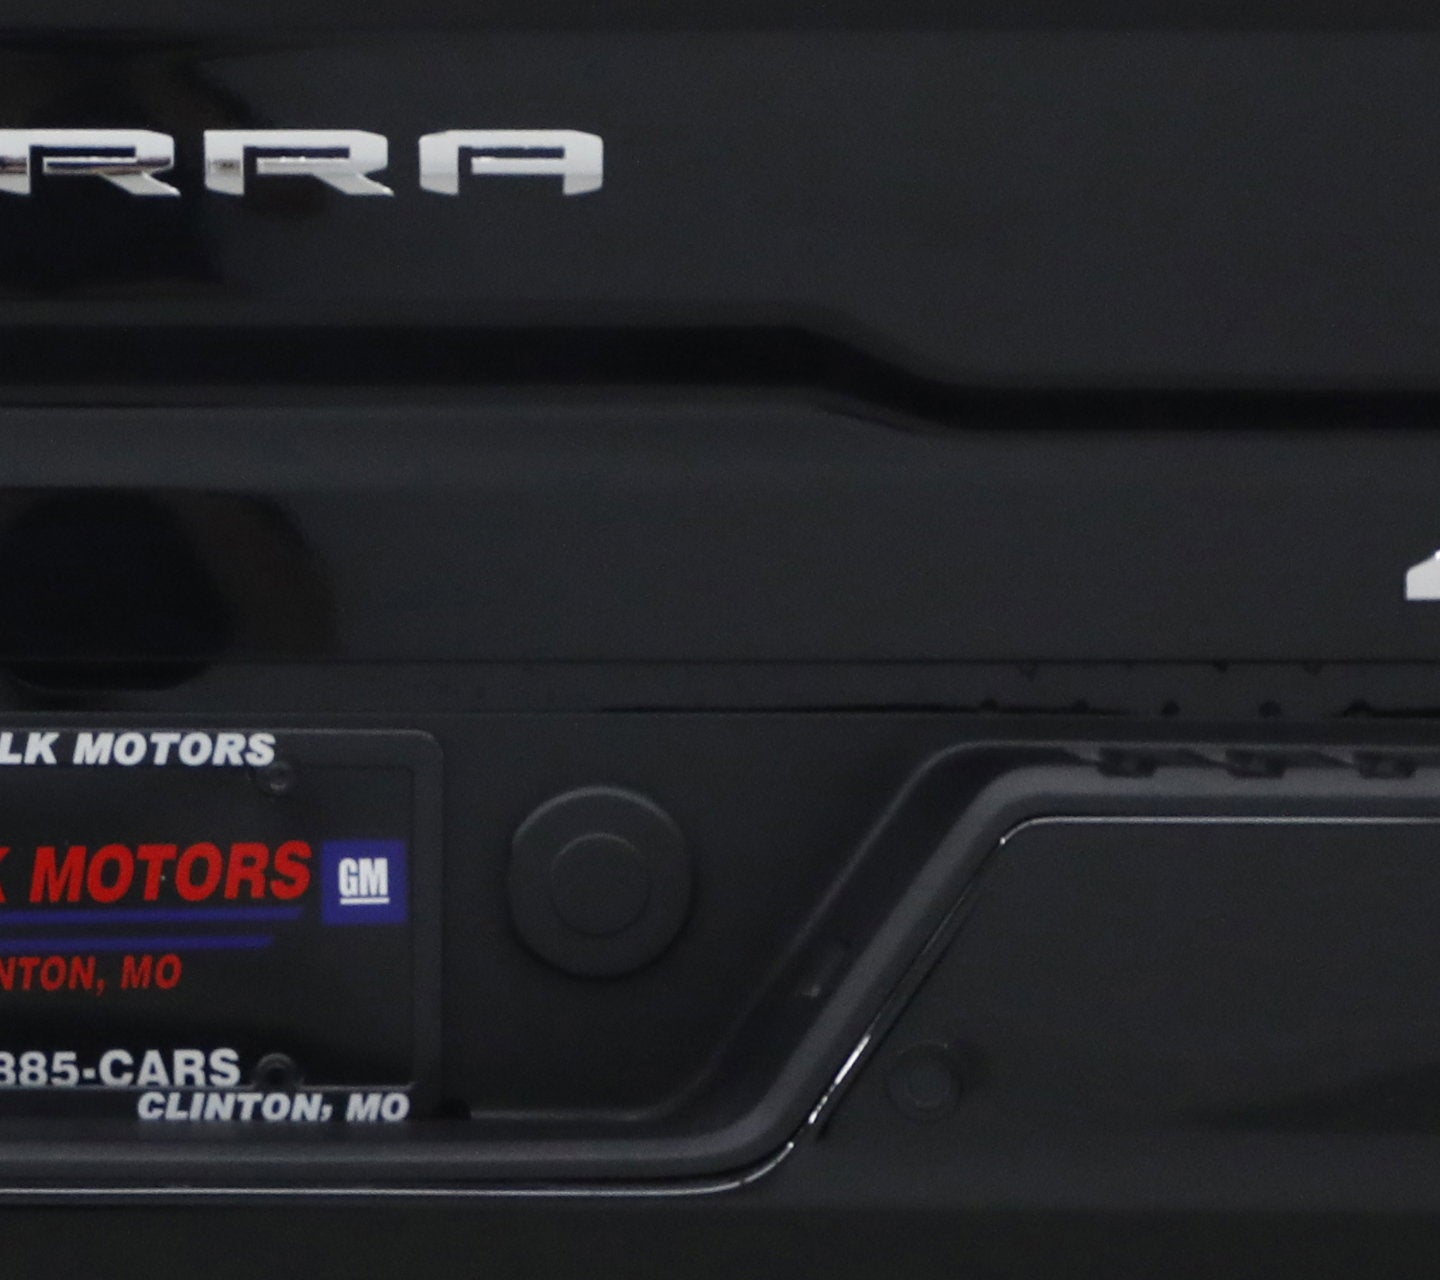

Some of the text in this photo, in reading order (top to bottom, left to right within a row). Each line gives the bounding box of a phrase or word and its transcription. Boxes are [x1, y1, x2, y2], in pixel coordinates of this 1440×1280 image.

[71, 731, 277, 767] MOTORS
[28, 840, 313, 904] MOTORS
[337, 856, 390, 898] GM
[119, 953, 184, 990] MO
[136, 1091, 410, 1122] CLINTON, MO
